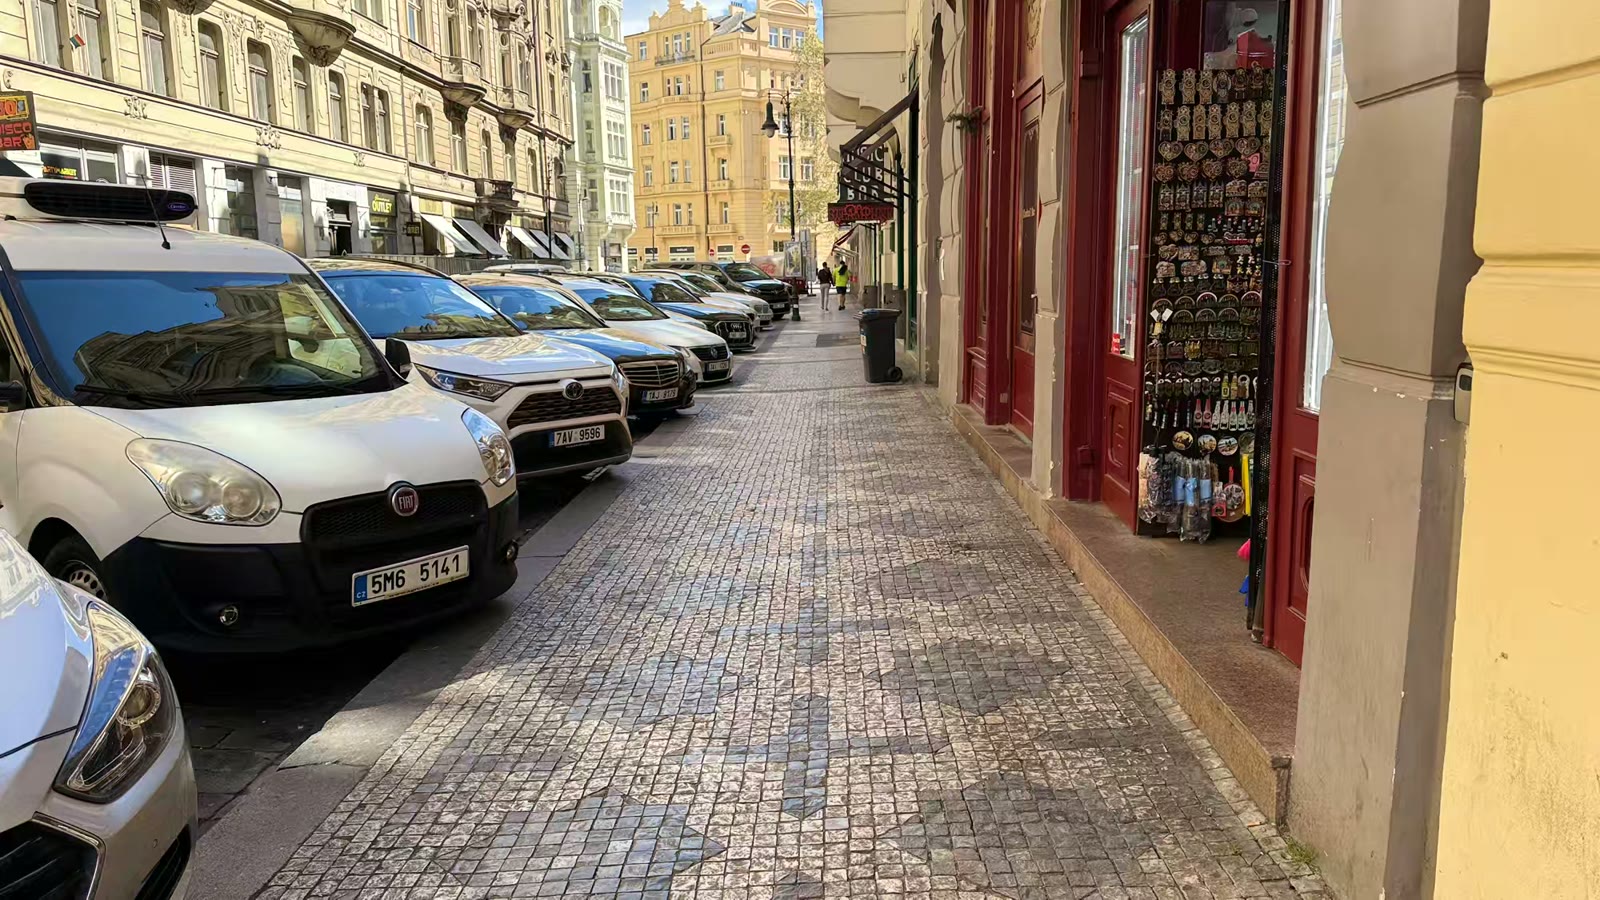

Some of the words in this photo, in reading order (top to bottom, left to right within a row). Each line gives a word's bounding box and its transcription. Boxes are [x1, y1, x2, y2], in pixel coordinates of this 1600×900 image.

[0, 122, 32, 134] ISCO
[372, 200, 392, 213] OUTLET
[556, 430, 573, 444] 7AV
[579, 427, 600, 441] 9596
[398, 495, 414, 509] FIAT
[371, 569, 406, 594] 5M6
[420, 554, 460, 582] 5141
[356, 591, 366, 599] CZ
